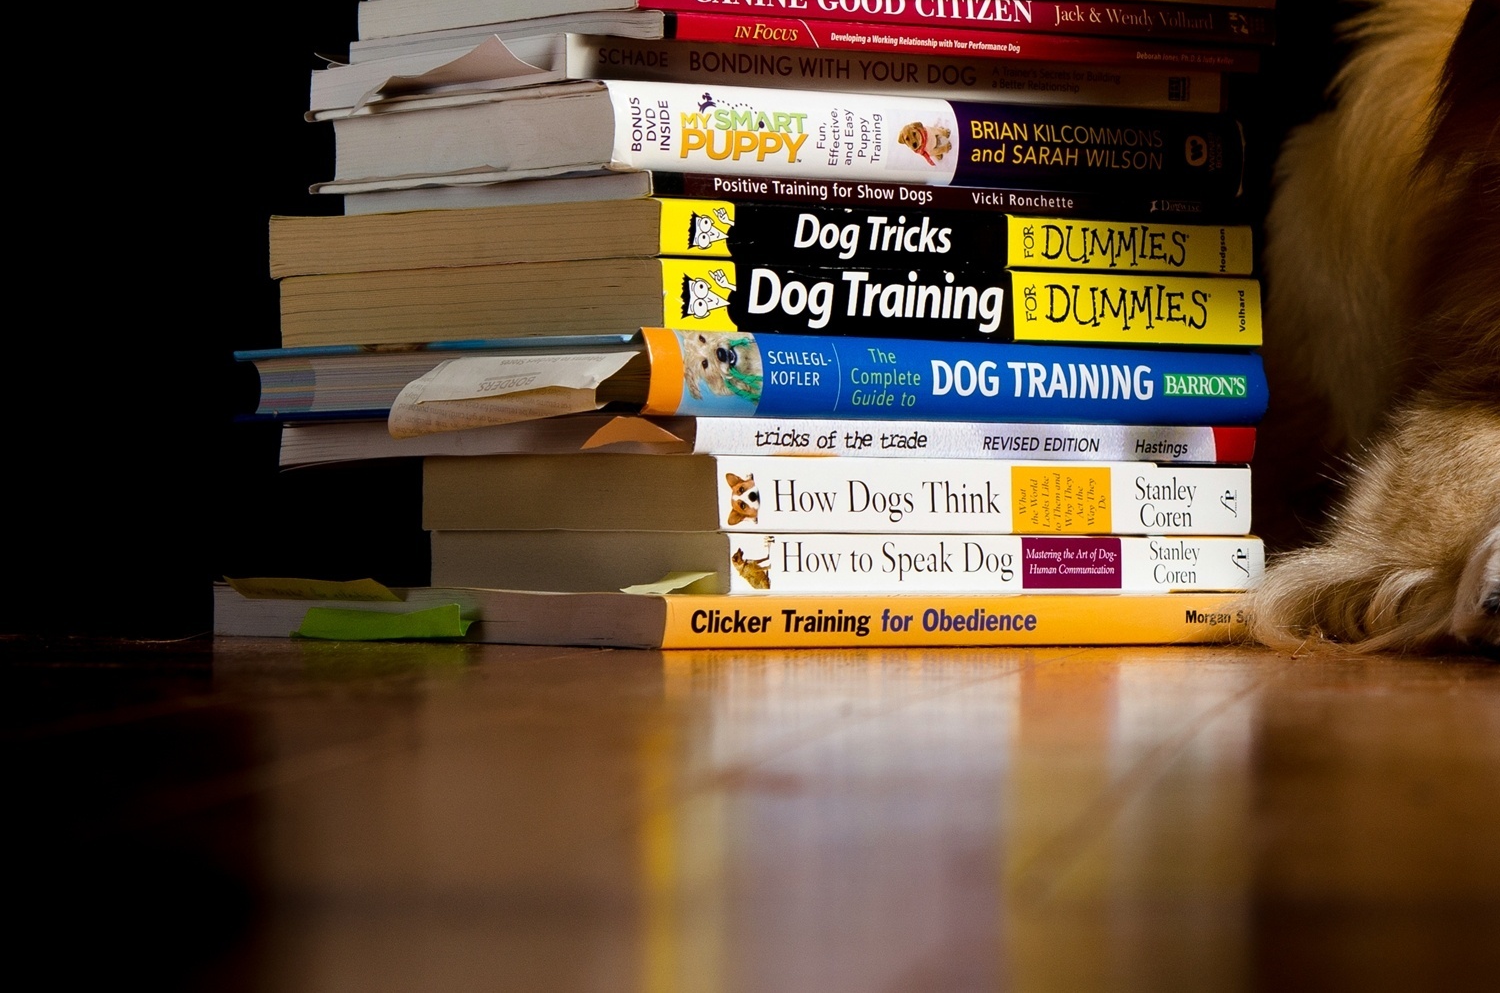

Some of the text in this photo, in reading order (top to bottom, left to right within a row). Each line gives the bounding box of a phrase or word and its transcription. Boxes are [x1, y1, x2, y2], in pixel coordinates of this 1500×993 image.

[680, 109, 808, 133] MY SMART
[680, 129, 809, 164] PUPPY
[714, 177, 933, 205] Positive Training for Show Dogs
[972, 192, 1074, 209] Vicki Ronchette
[794, 213, 952, 260] Dog Tricks
[1023, 224, 1035, 259] FOR
[1041, 224, 1188, 267] DUMMIES
[747, 268, 1004, 334] Dog Training
[1025, 284, 1037, 323] FOR
[1044, 283, 1209, 331] DUMMIES
[767, 350, 832, 367] SCHLEGL-
[867, 348, 897, 365] The
[771, 370, 820, 387] KOFLER
[850, 368, 921, 389] Complete
[931, 359, 1154, 402] DOG TRAINING
[1164, 375, 1246, 397] BARRON'S
[852, 389, 916, 408] Guide to
[754, 426, 928, 450] tricks of the trade
[983, 436, 1101, 453] REVISED EDITION
[1135, 439, 1189, 458] Hastings
[773, 479, 1001, 523] How Dogs Think
[1135, 476, 1197, 509] Stanley
[1140, 504, 1192, 528] Coren
[781, 541, 1014, 582] How to Speak Dog
[1149, 541, 1200, 566] Stanley
[1153, 564, 1197, 584] Coren
[691, 609, 1037, 637] Clicker Training for Obedience
